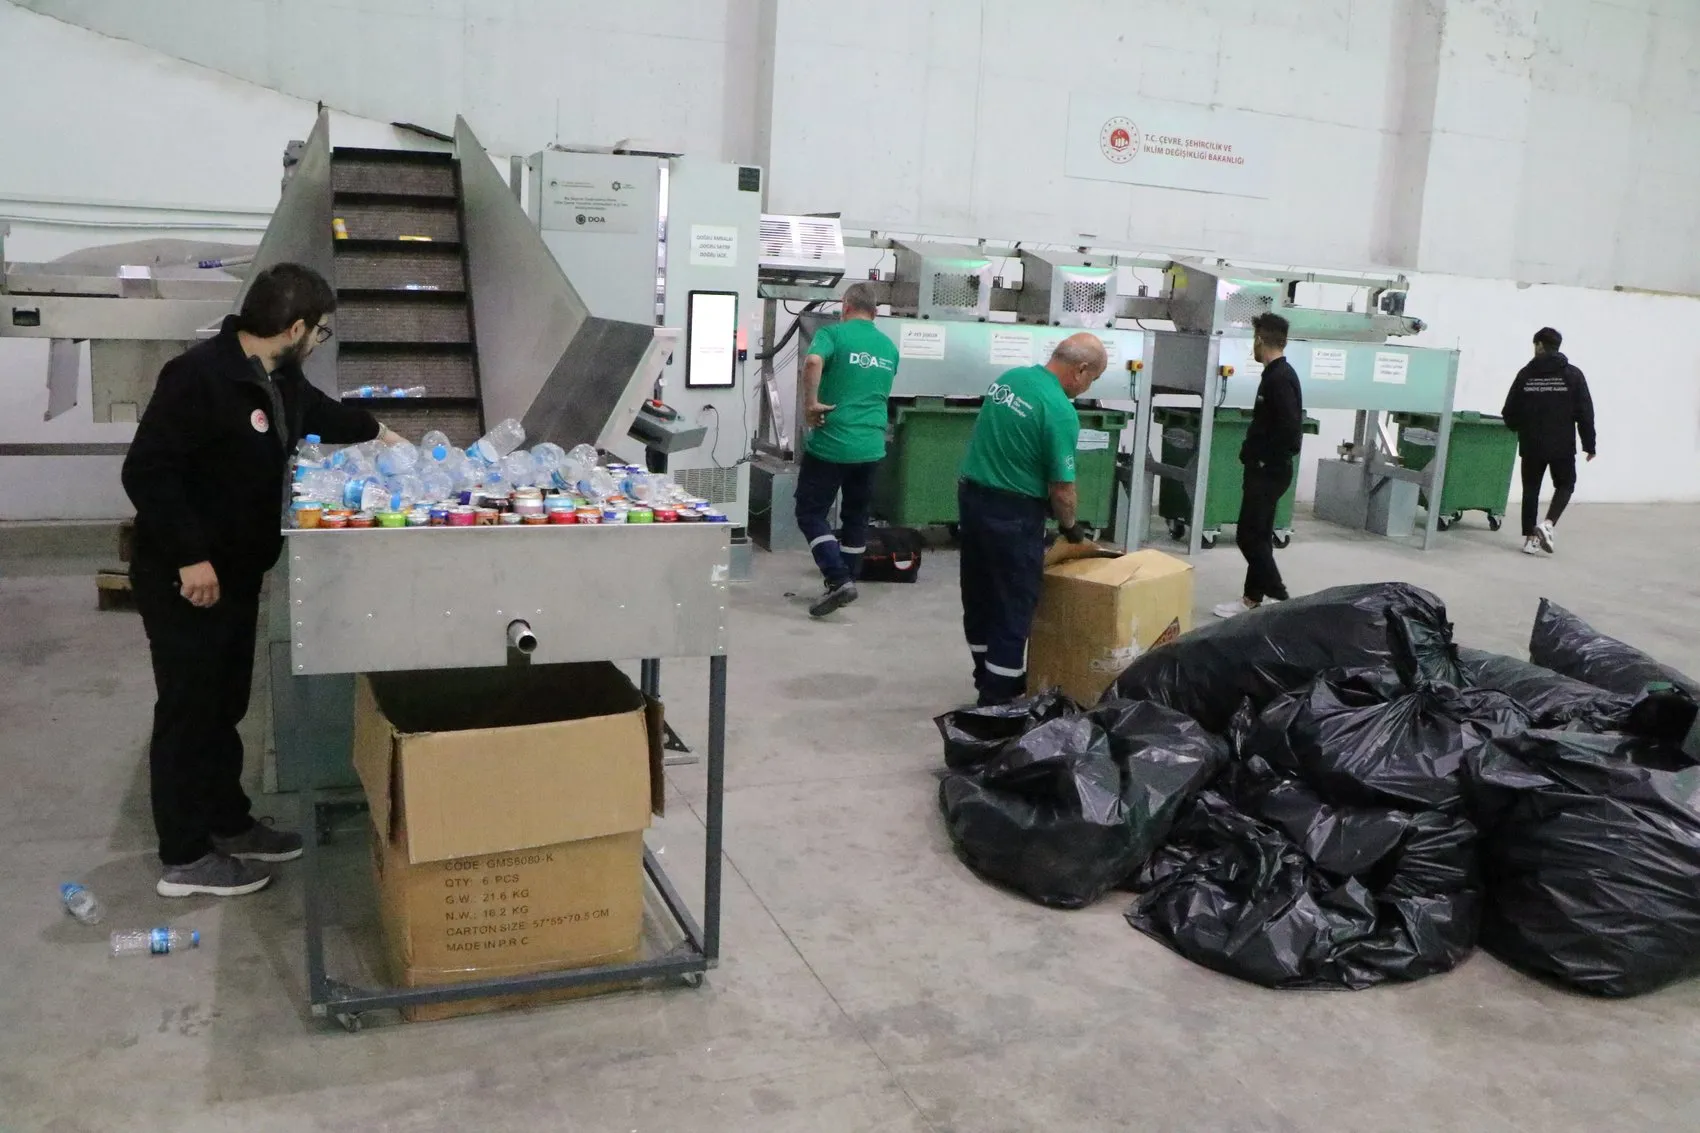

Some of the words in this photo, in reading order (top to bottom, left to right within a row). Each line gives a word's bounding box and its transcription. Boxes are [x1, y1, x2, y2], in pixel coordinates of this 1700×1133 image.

[1144, 134, 1158, 142] T.C.
[1223, 144, 1232, 152] VE
[1143, 145, 1163, 154] İKLİM
[1208, 153, 1244, 165] BAKANLIĞI
[849, 352, 879, 368] DOA
[987, 382, 1015, 407] DOA
[482, 876, 489, 885] 6
[495, 874, 519, 884] PCS
[513, 889, 529, 898] KG
[512, 905, 529, 915] KG
[446, 925, 497, 936] CARTON
[592, 908, 609, 919] CM
[446, 941, 480, 952] MADE
[484, 940, 495, 949] IN
